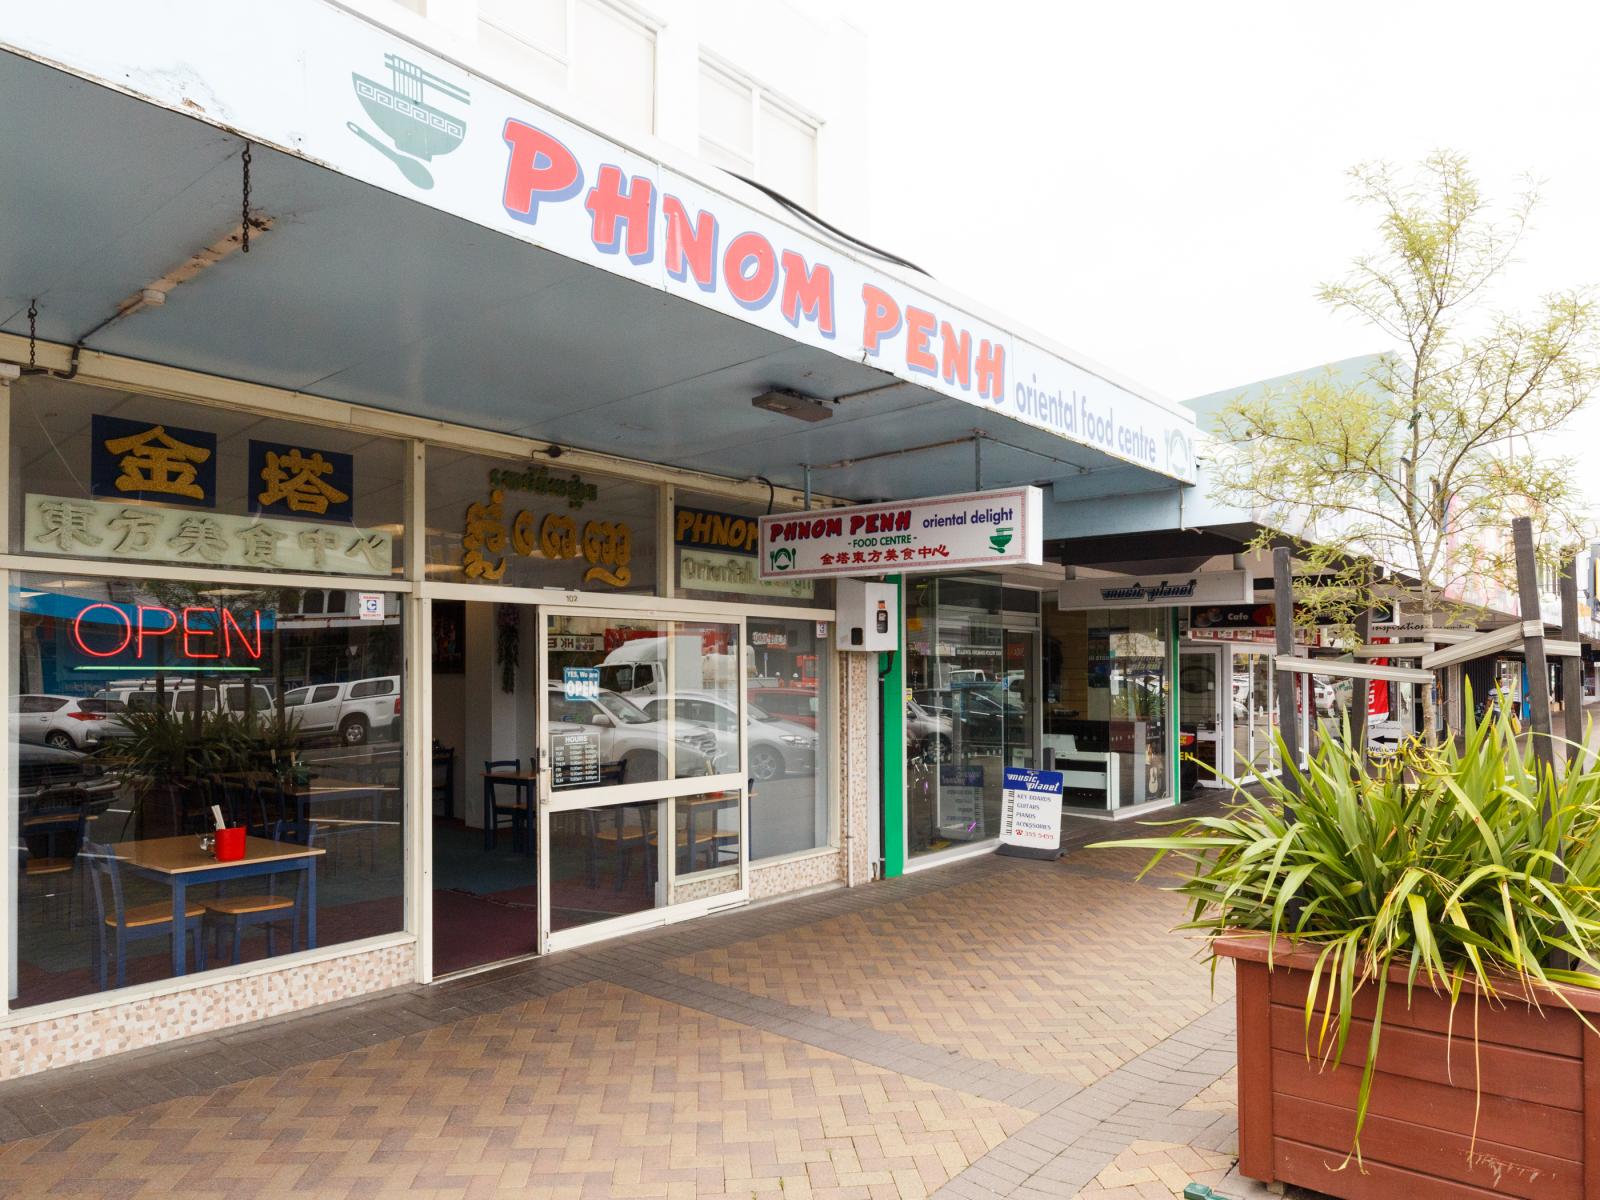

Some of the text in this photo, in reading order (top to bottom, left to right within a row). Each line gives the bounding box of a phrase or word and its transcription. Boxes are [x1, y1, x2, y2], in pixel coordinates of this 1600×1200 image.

[502, 117, 1005, 404] PHNOM PENH
[1015, 373, 1156, 463] oriental food centre
[104, 424, 350, 515] 金塔
[770, 510, 912, 542] PHNOM PENH
[923, 508, 1013, 528] oriental delight
[36, 502, 390, 571] 東方美食中心
[853, 535, 912, 548] FOOD CENTRE
[820, 544, 949, 565] 金塔東方美食中心
[1147, 579, 1197, 601] planet
[74, 603, 262, 659] OPEN
[567, 680, 598, 696] OPEN
[1007, 772, 1038, 783] music
[1026, 780, 1060, 791] planet
[1016, 821, 1051, 830] ACCESSORIES
